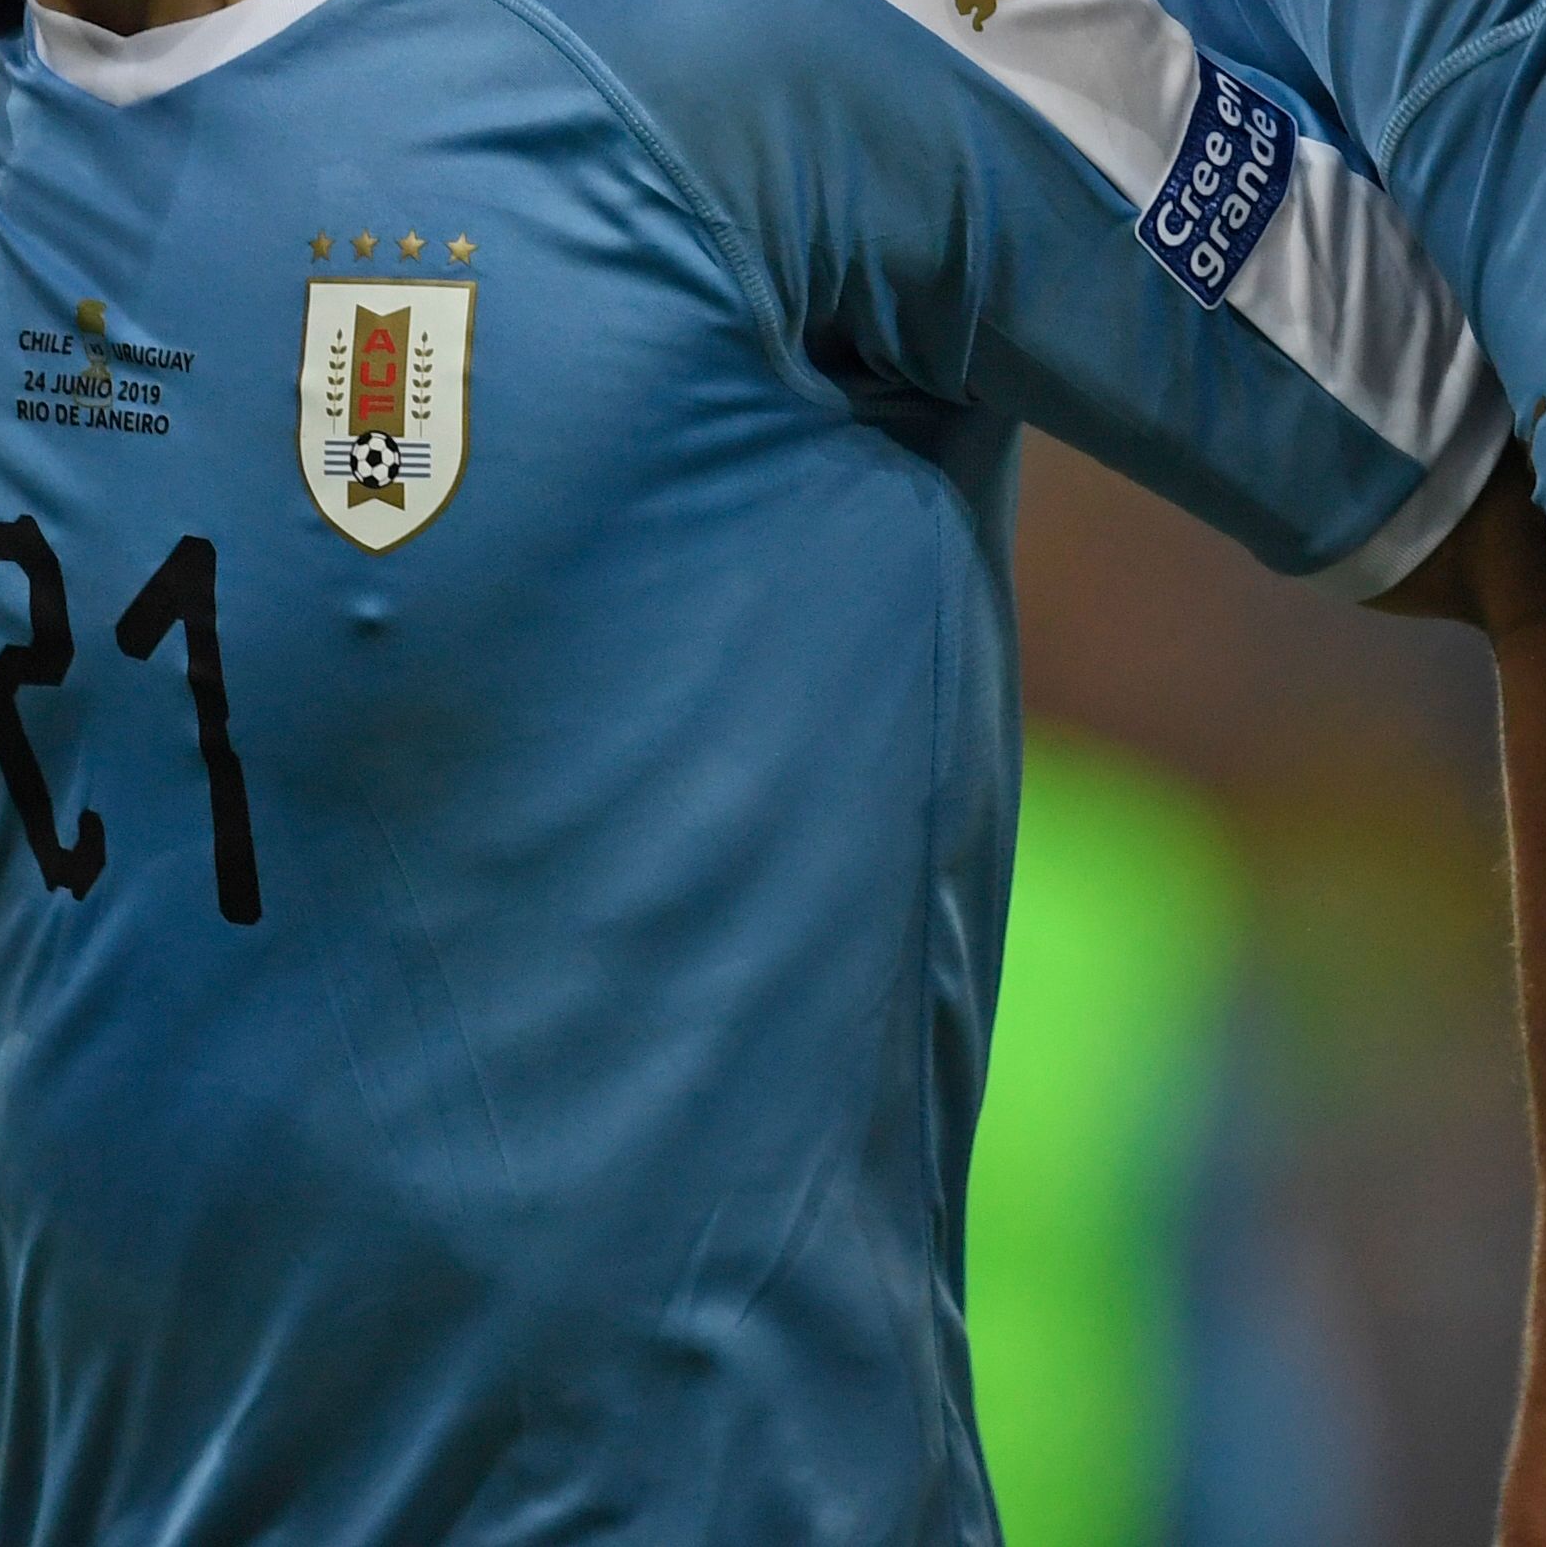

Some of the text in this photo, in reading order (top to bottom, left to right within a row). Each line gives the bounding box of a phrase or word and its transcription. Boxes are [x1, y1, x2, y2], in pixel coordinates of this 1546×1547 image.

[1156, 71, 1242, 247] Cree en
[1190, 107, 1278, 288] grande
[19, 330, 74, 355] CHILE
[111, 343, 196, 373] URUGUAY
[359, 328, 397, 421] AUF
[16, 399, 170, 435] RIO DE JANEIRO
[24, 370, 161, 404] 24 JUNIO 2019
